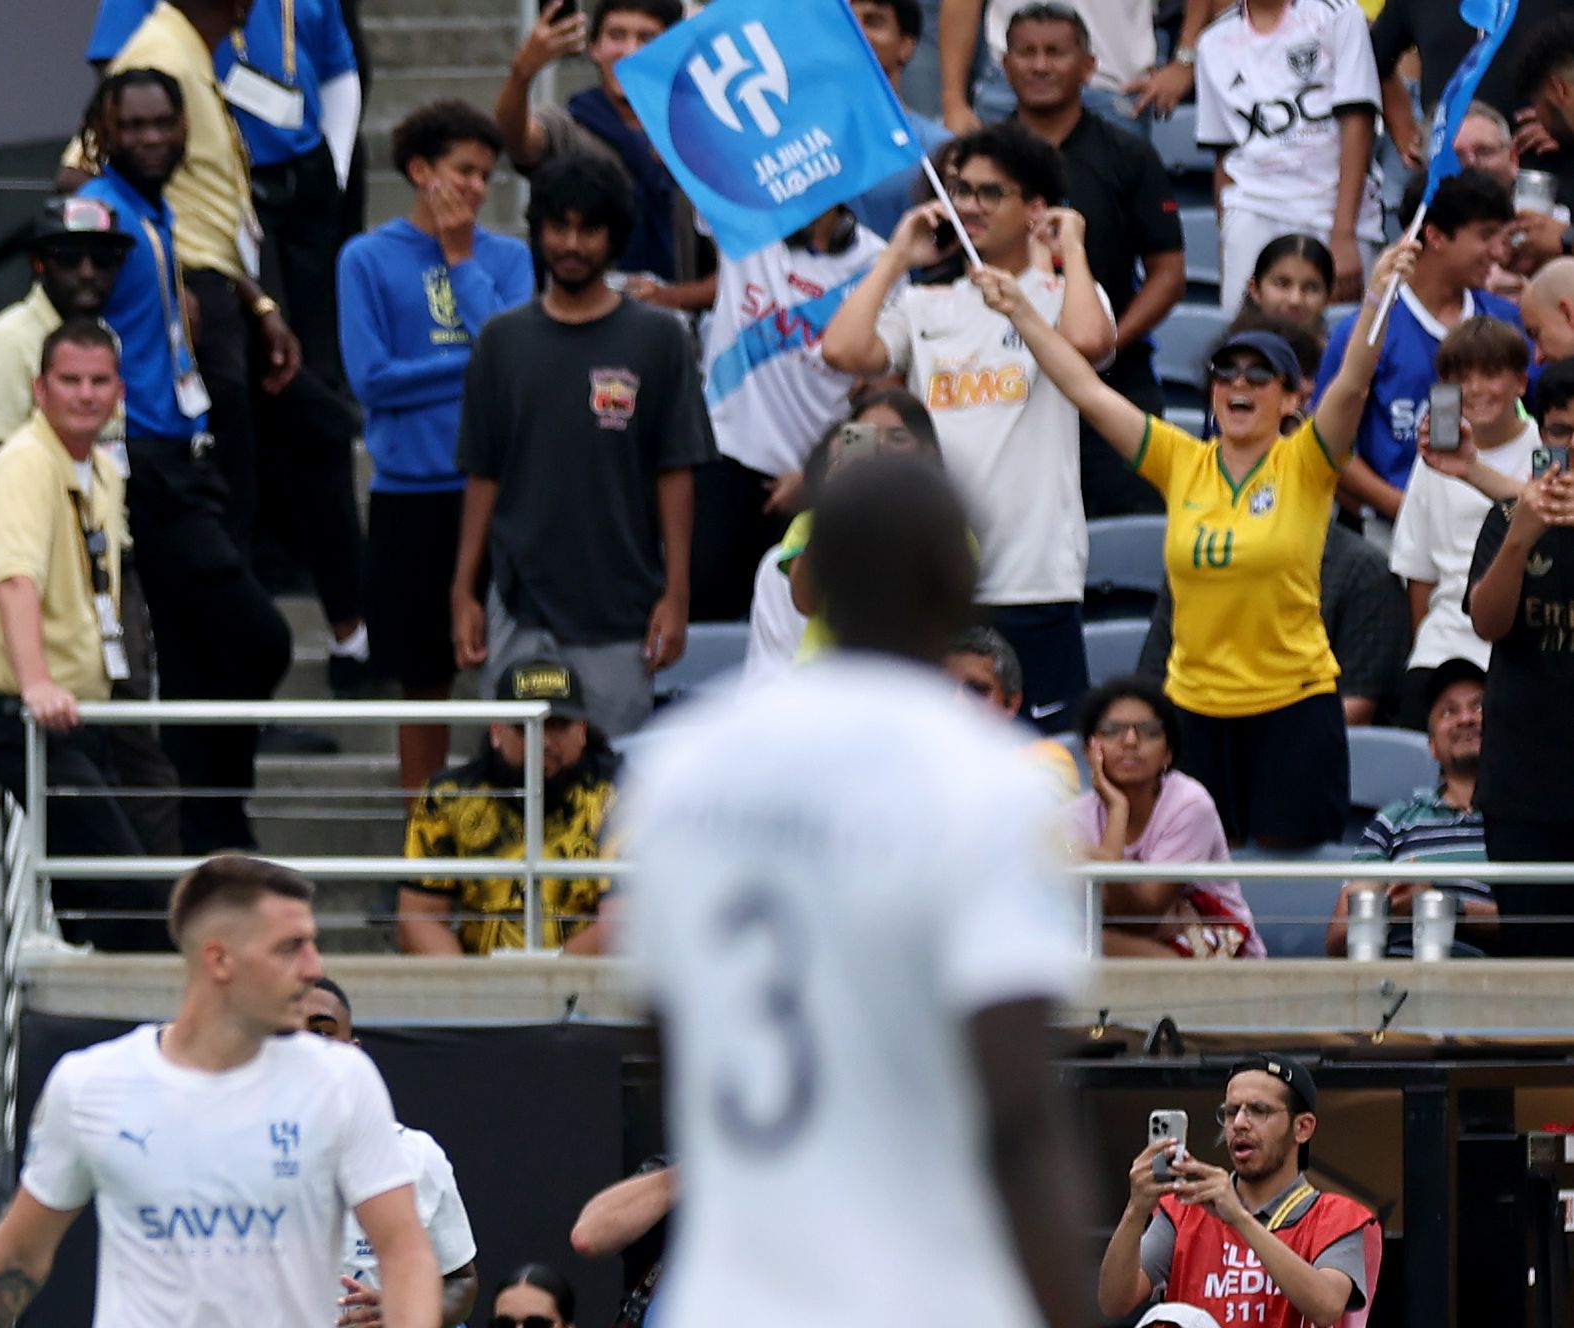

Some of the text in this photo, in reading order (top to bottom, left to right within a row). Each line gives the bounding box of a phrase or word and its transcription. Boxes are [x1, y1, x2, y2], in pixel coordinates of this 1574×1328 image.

[927, 364, 1029, 410] BMG
[709, 880, 822, 1160] 3
[140, 1206, 286, 1239] SAVVY
